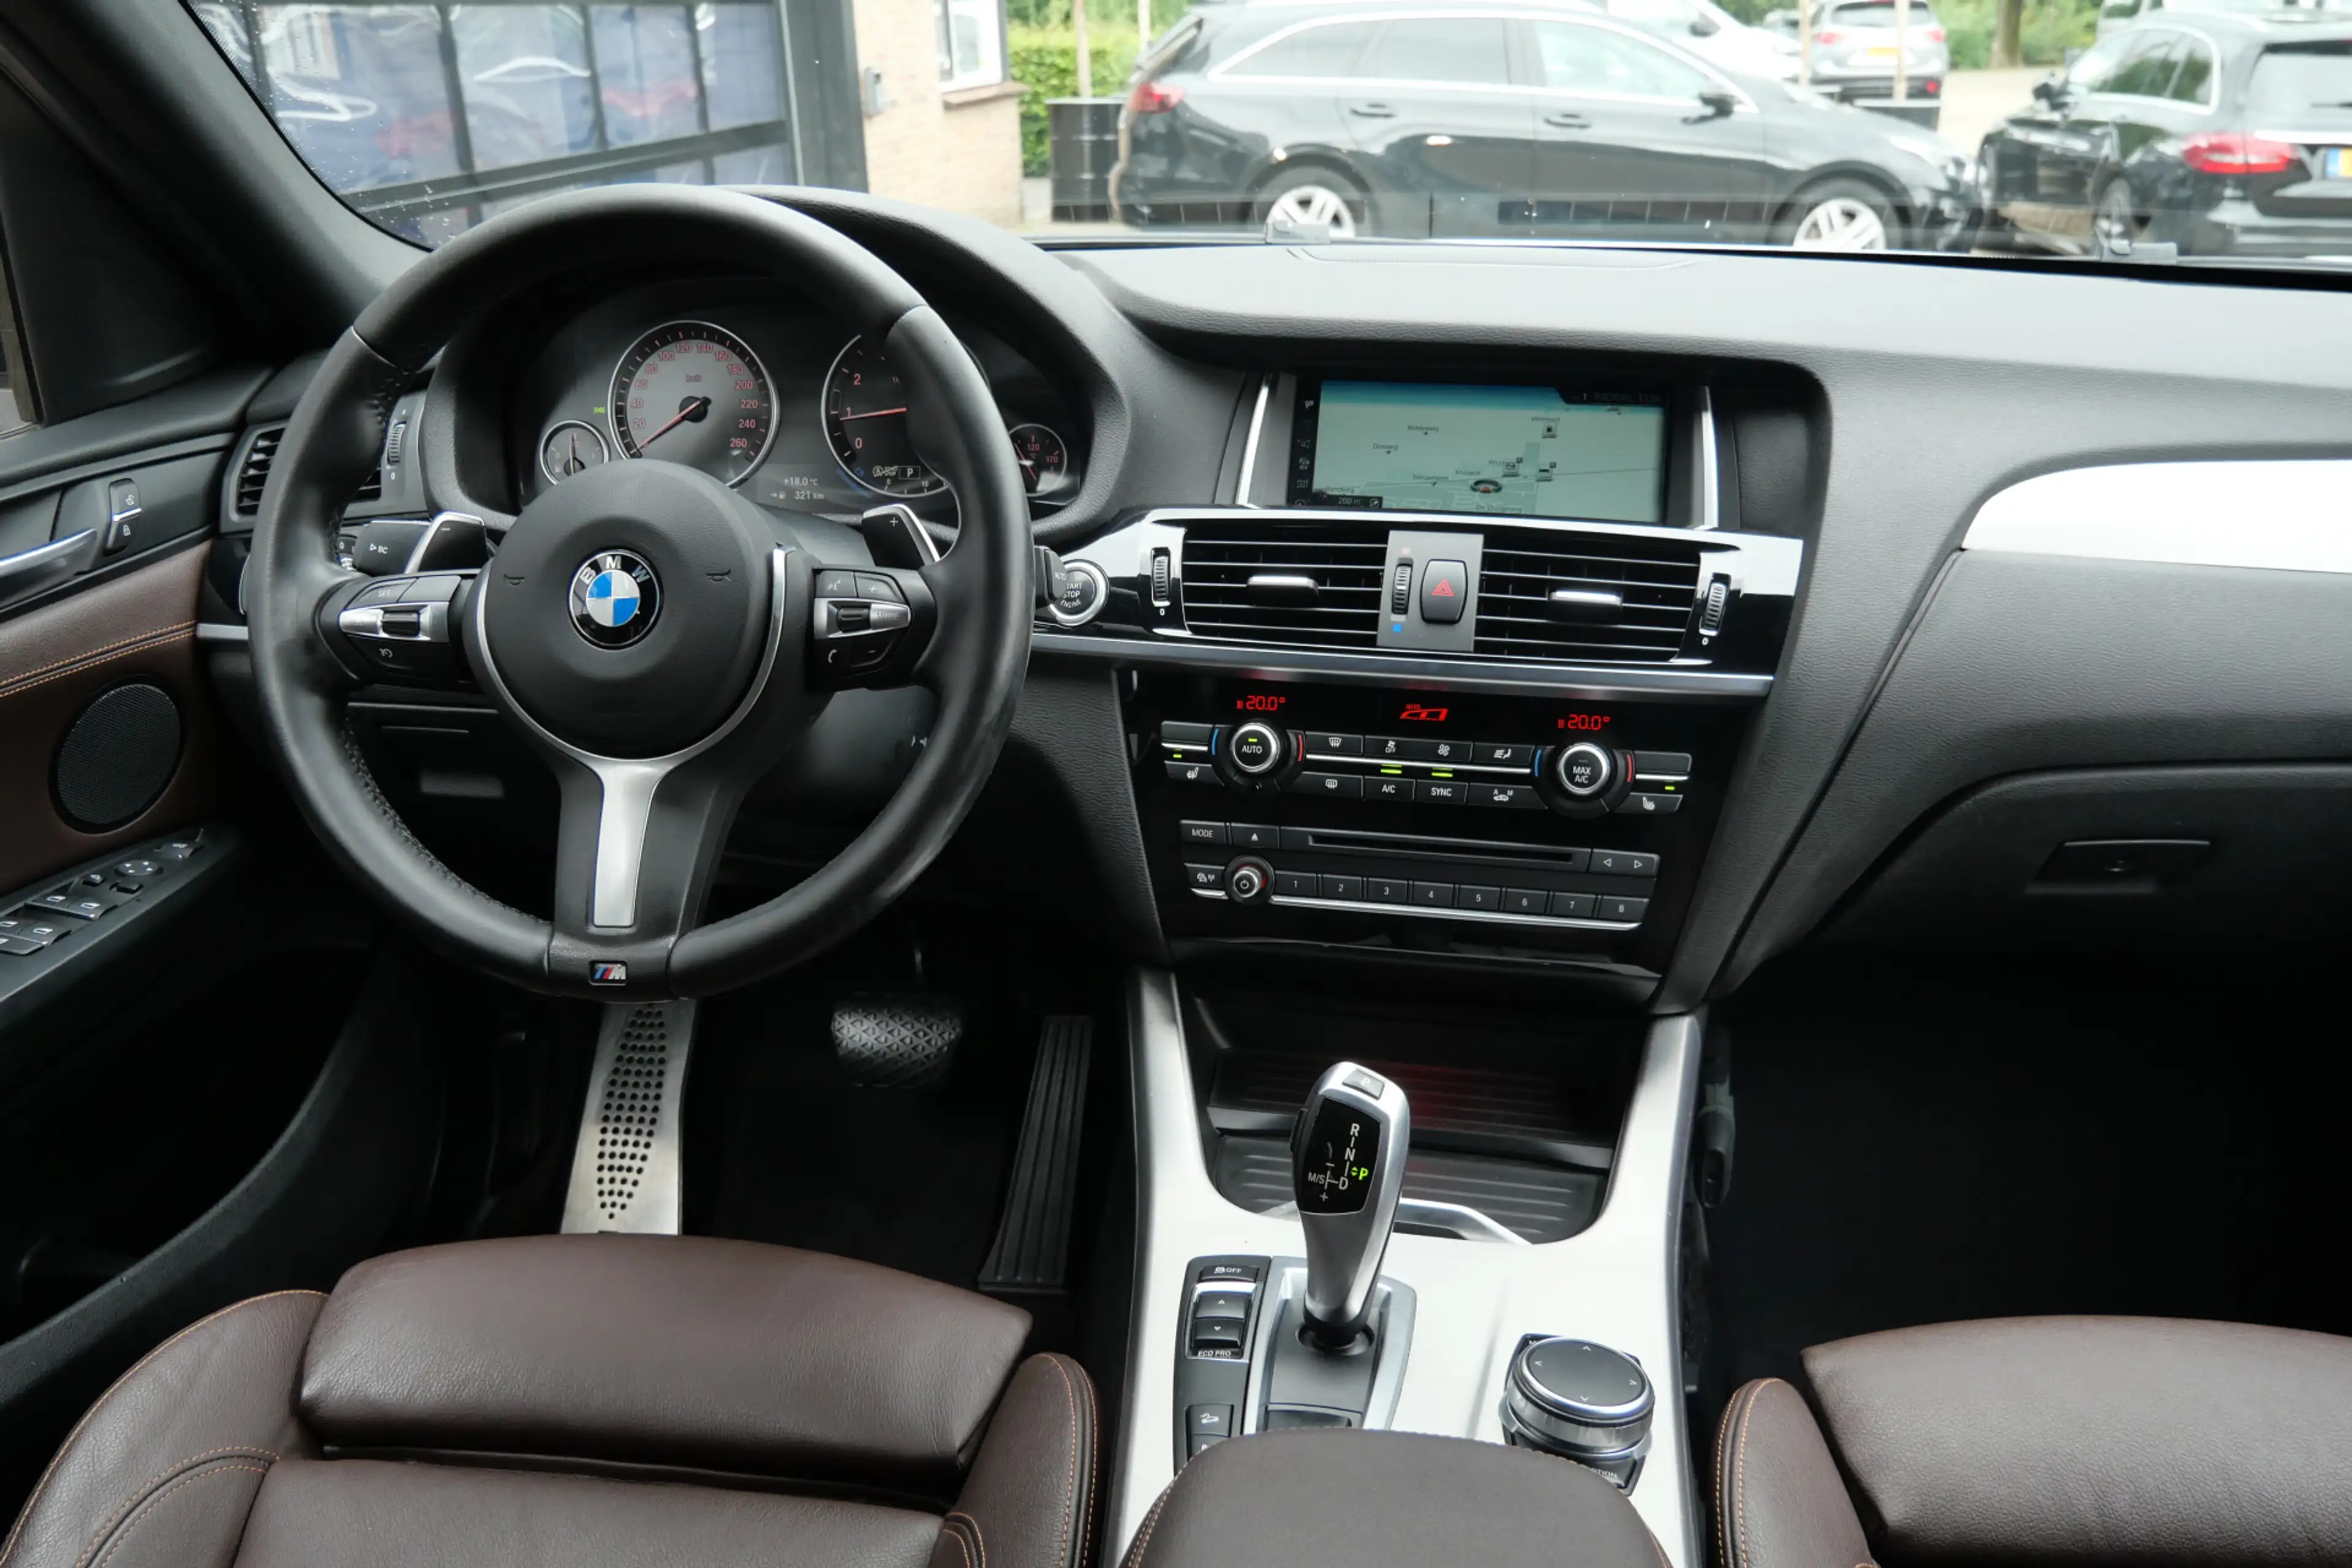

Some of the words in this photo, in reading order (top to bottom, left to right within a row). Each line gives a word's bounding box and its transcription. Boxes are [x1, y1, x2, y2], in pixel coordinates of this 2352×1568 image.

[676, 343, 692, 353] 120
[696, 343, 713, 353] 140
[658, 352, 674, 361] 100
[714, 352, 731, 362] 160
[728, 365, 744, 375] 180
[854, 374, 861, 385] 2
[635, 380, 647, 390] 60
[736, 380, 753, 390] 200
[631, 399, 643, 409] 40
[741, 398, 758, 409] 220
[846, 407, 851, 417] 1
[633, 418, 646, 428] 20
[739, 419, 756, 429] 240
[729, 437, 747, 448] 260
[855, 437, 862, 448] 0
[907, 468, 913, 477] P
[794, 491, 810, 500] 321
[579, 555, 651, 582] BMW
[1242, 744, 1262, 755] AUTO
[1573, 766, 1591, 775] MAX
[1574, 775, 1589, 784] A/C
[1382, 784, 1395, 794] A/C
[1431, 786, 1452, 797] SYNC
[1192, 829, 1213, 838] MODE
[1476, 894, 1482, 903] 5
[1522, 898, 1528, 907] 6
[1570, 901, 1575, 910] 7
[1618, 904, 1624, 913] 8
[1349, 1123, 1360, 1137] R
[1344, 1147, 1356, 1161] N
[1308, 1171, 1325, 1185] M/S
[1359, 1167, 1369, 1180] P
[1338, 1177, 1349, 1190] D
